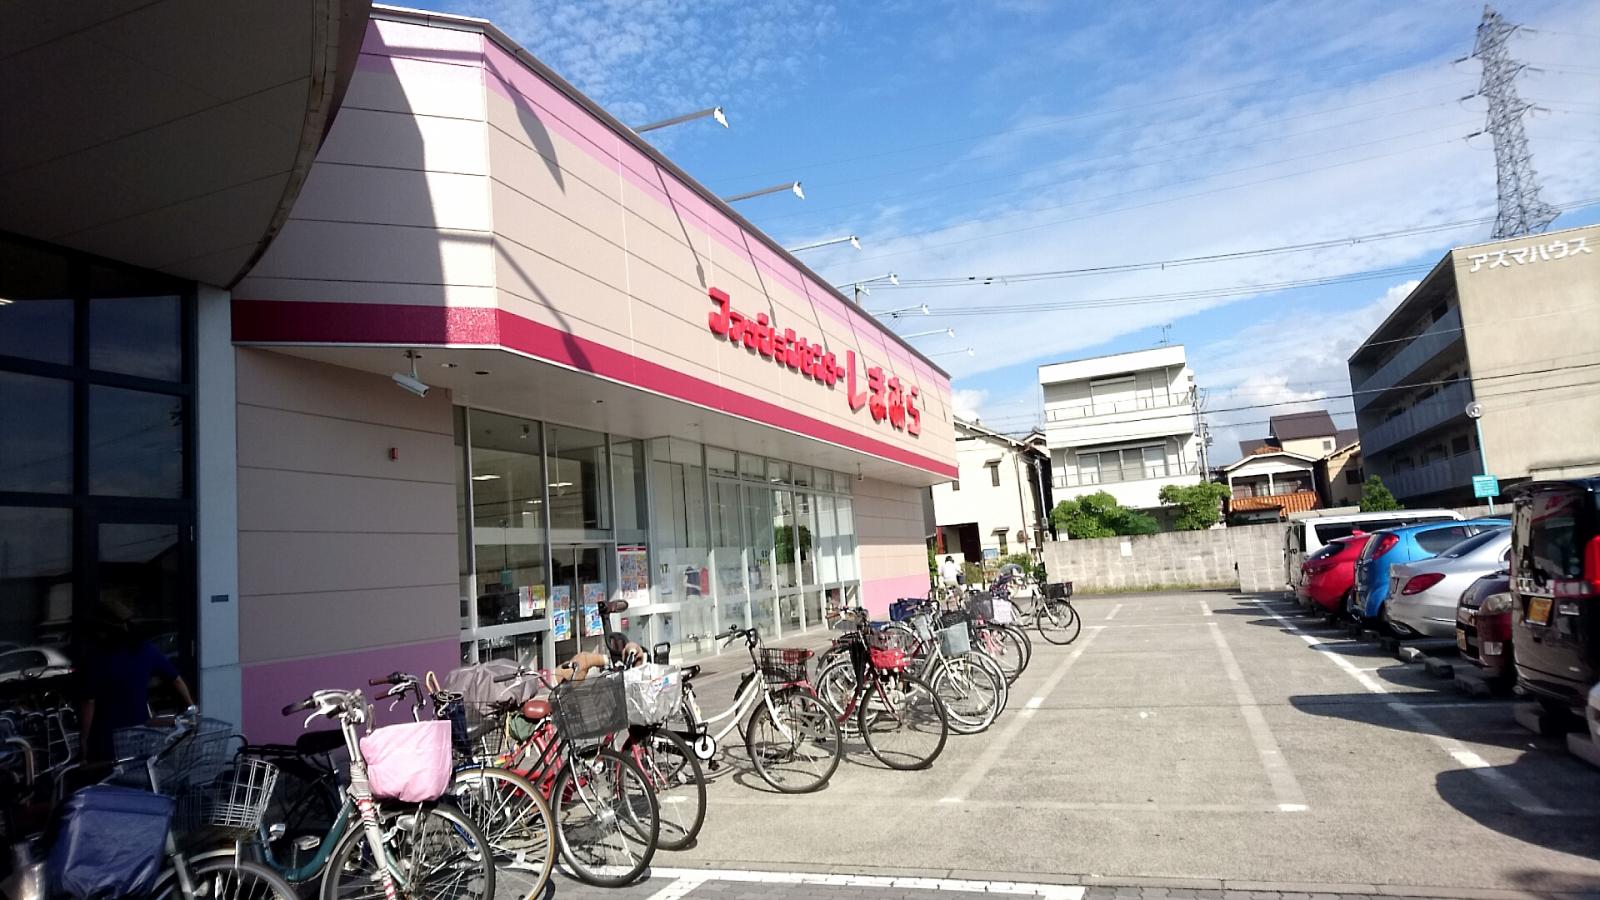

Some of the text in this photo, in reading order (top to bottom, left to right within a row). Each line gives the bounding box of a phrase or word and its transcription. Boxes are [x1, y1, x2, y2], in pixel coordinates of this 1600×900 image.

[1467, 237, 1593, 273] アズマハウス
